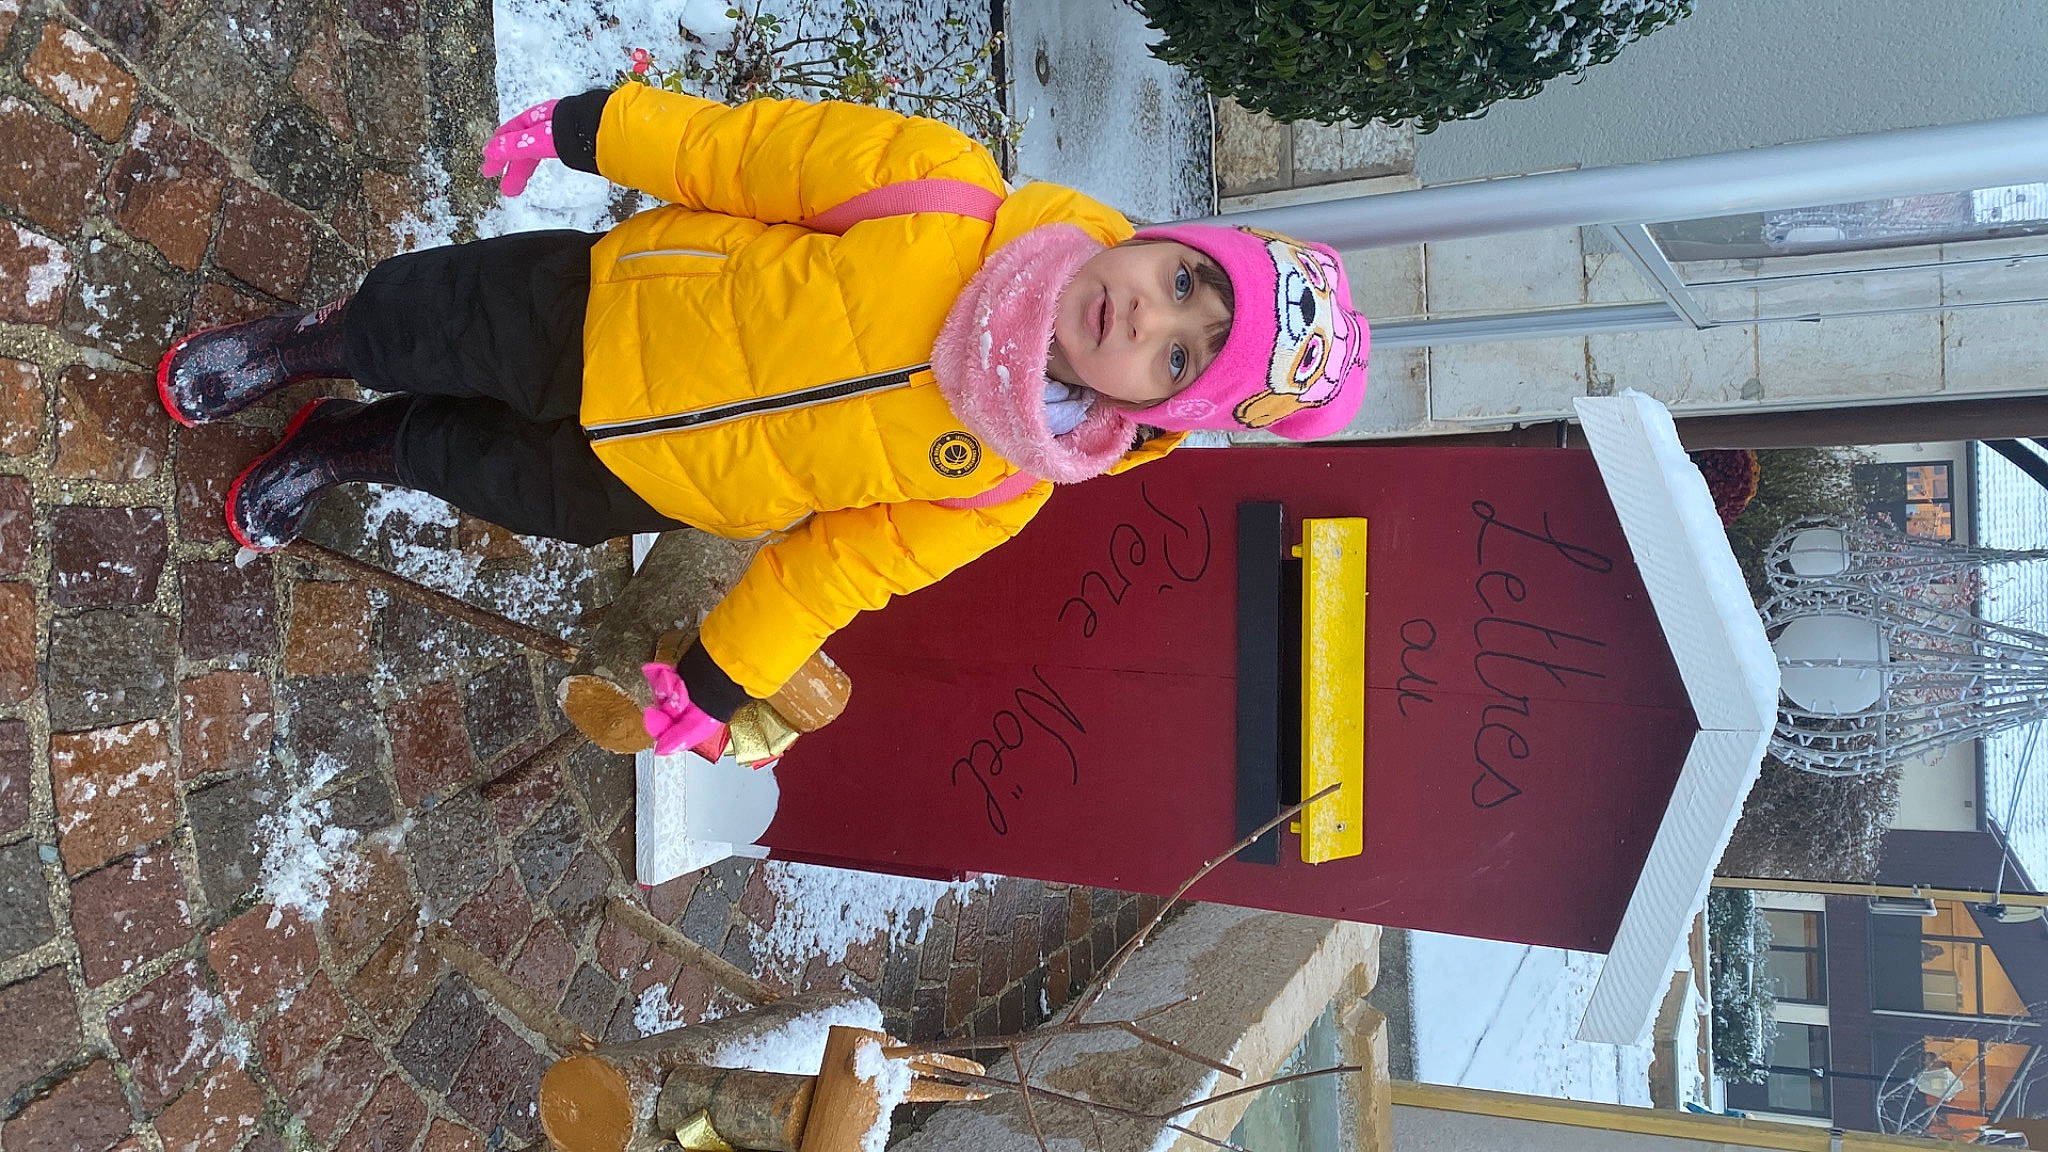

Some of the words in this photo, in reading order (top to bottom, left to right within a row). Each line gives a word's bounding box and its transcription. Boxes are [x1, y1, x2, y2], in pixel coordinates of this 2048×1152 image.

[1057, 481, 1210, 639] Père
[1396, 618, 1438, 717] au
[1471, 499, 1613, 809] Lettres
[952, 665, 1086, 836] Noël
